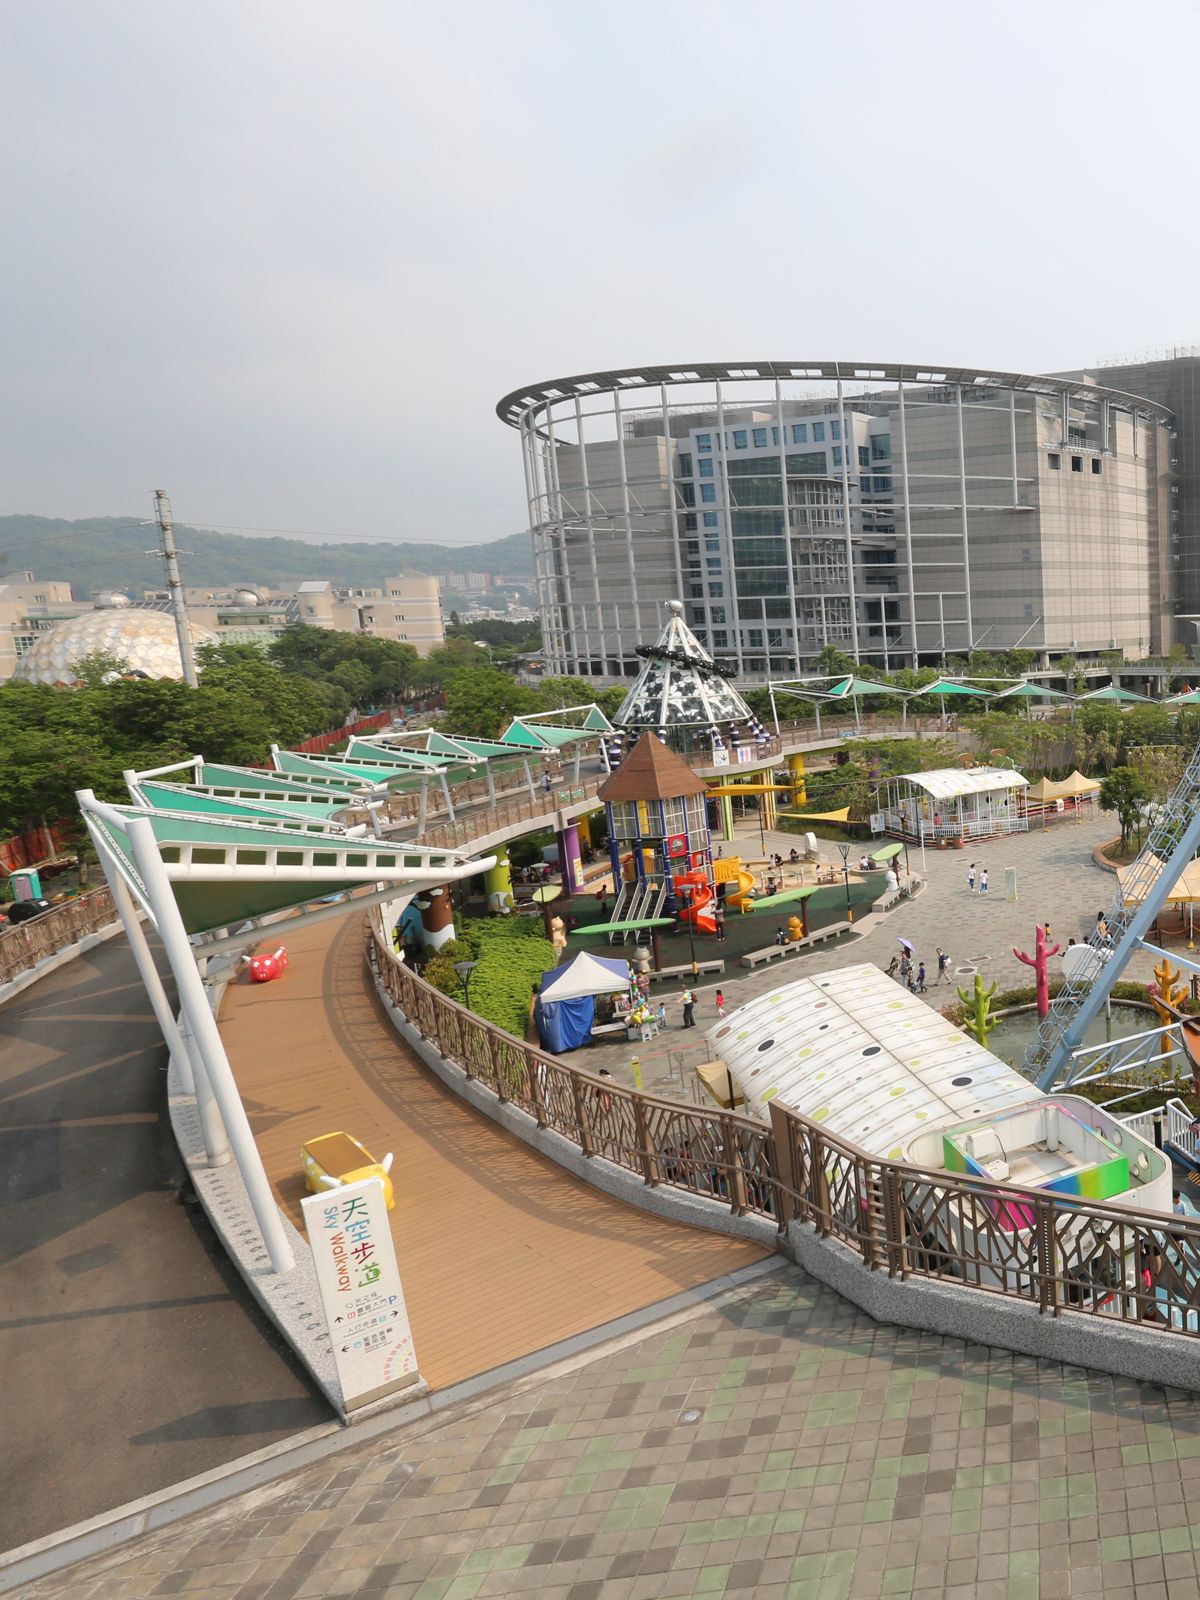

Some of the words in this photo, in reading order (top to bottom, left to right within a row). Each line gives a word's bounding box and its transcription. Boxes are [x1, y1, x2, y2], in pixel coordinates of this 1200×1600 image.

[323, 1206, 339, 1229] Sky
[330, 1231, 352, 1292] Walkway
[342, 1196, 381, 1288] 天空步道
[388, 1295, 397, 1305] P
